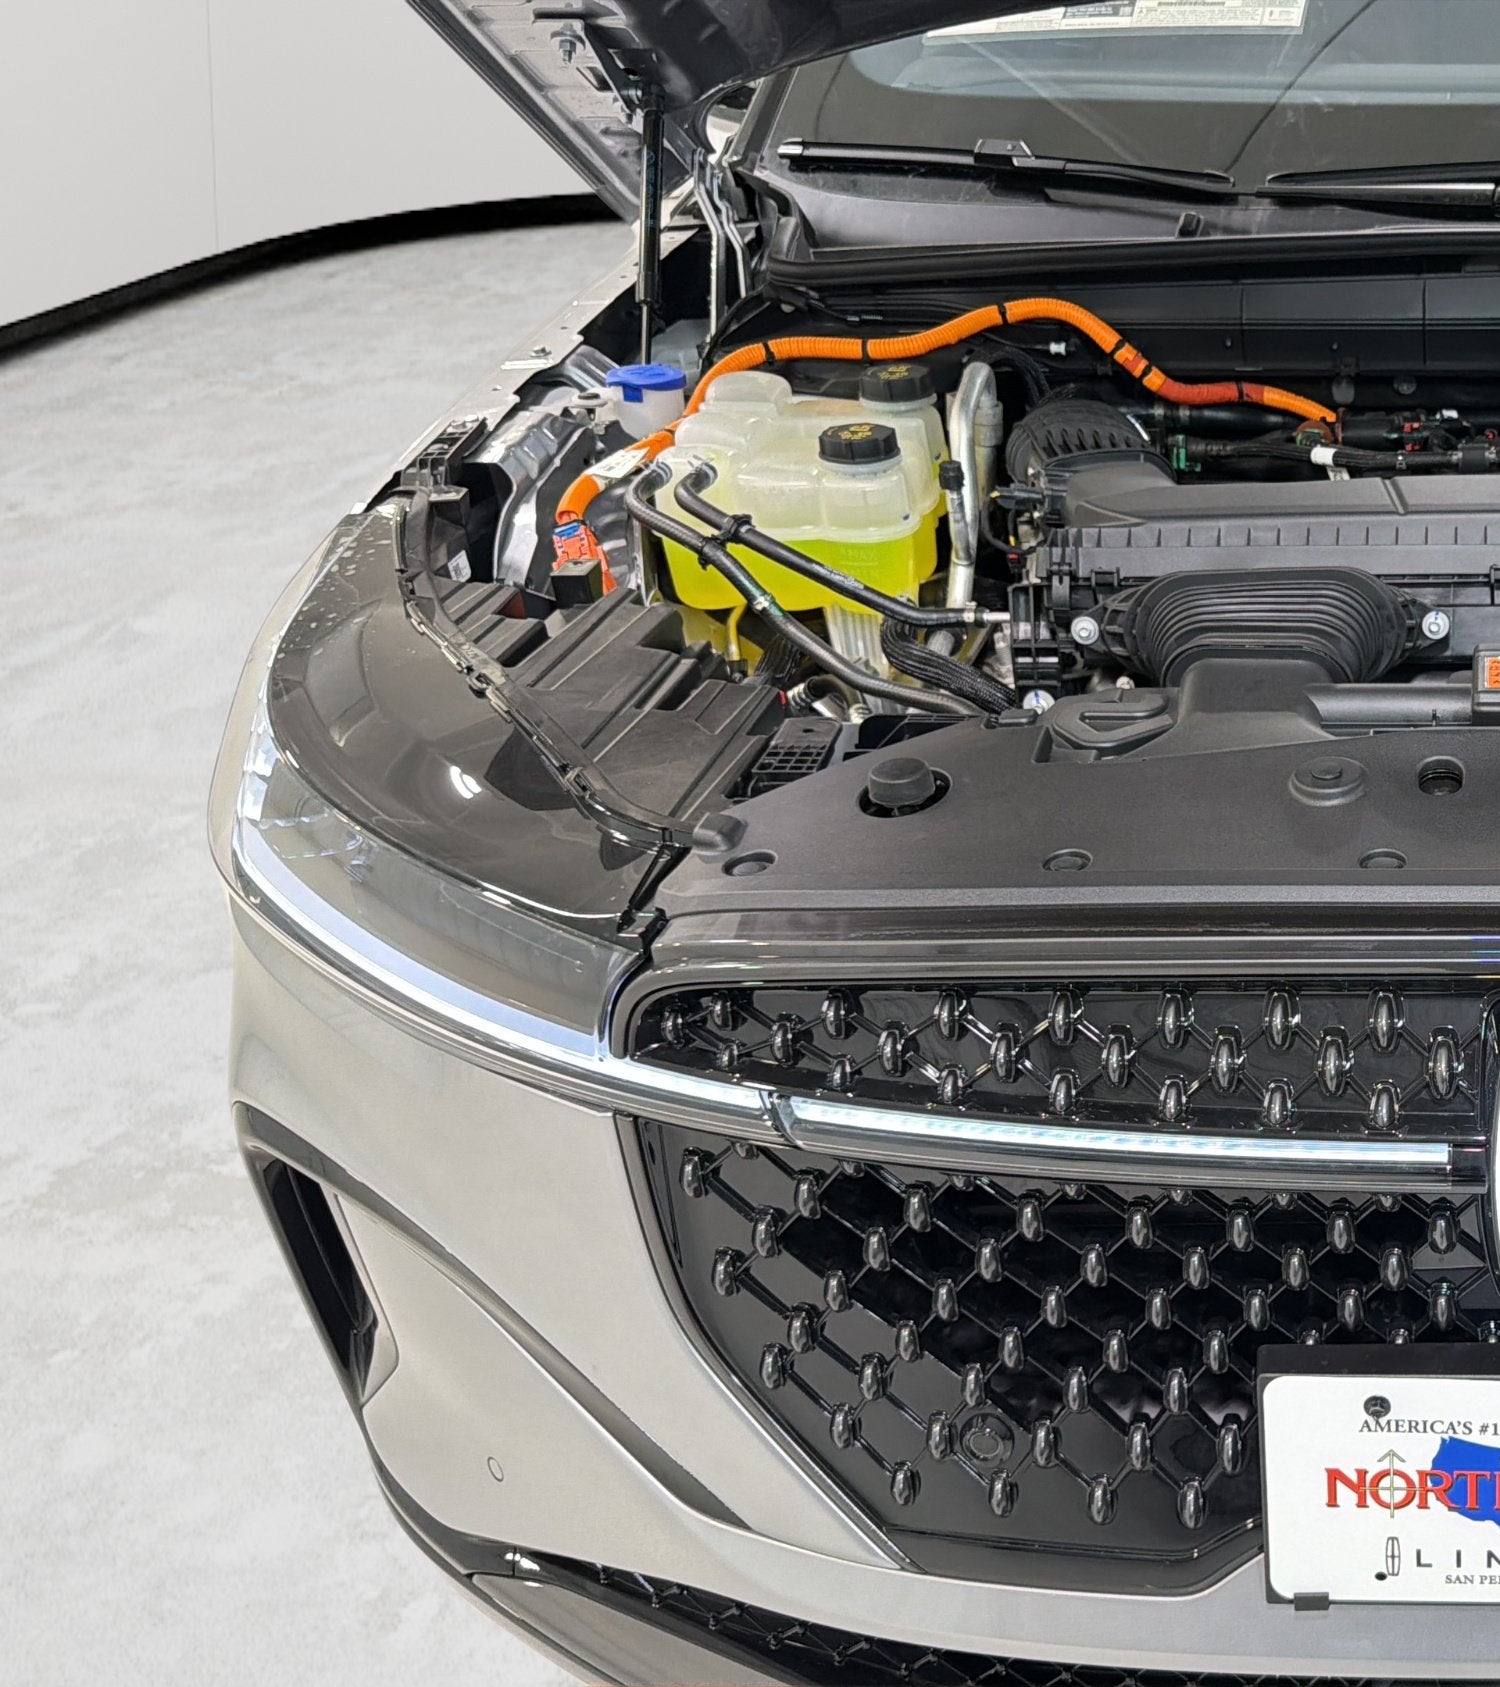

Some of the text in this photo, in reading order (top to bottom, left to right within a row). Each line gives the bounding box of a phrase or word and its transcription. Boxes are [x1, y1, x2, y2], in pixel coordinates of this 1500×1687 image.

[1358, 1419, 1473, 1435] AMERICA'S
[1479, 1422, 1500, 1436] #1
[1445, 1574, 1475, 1585] SAN
